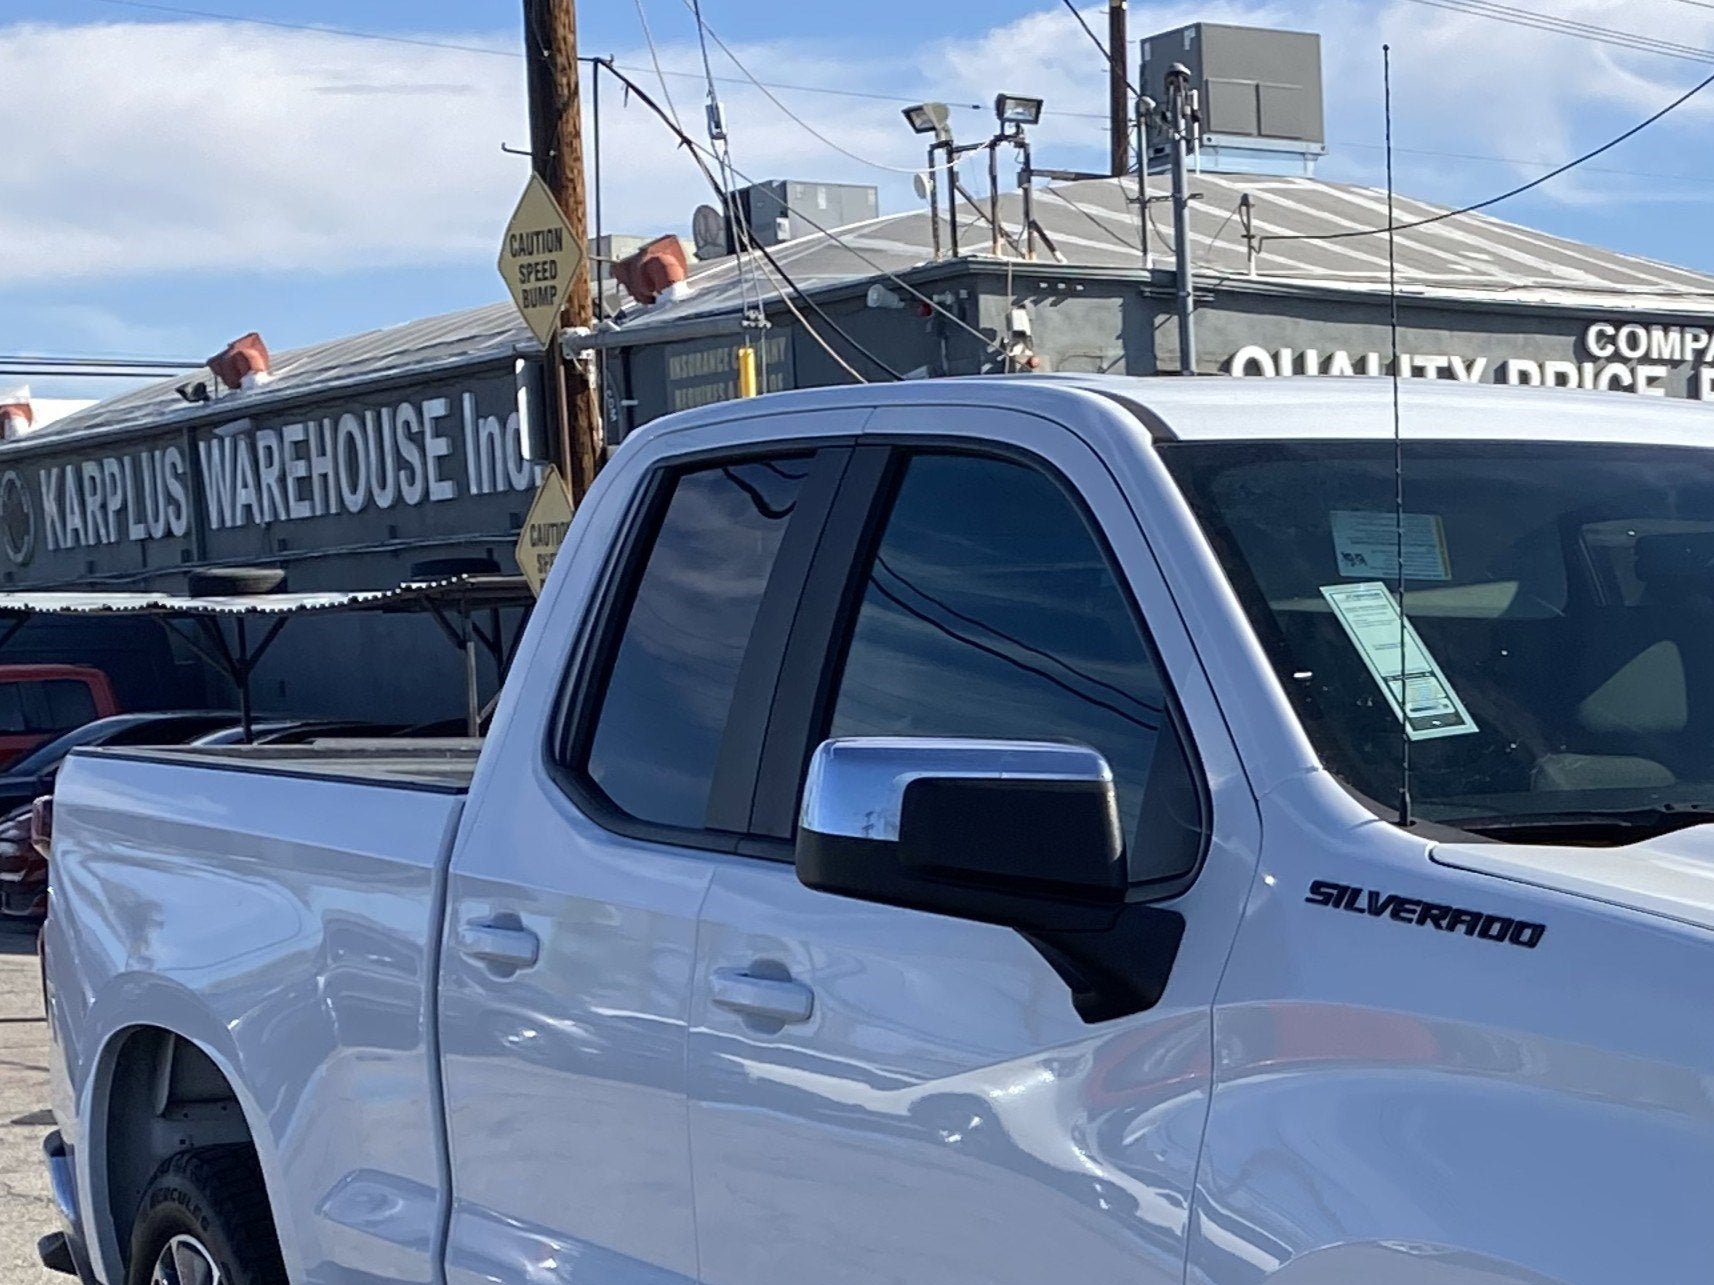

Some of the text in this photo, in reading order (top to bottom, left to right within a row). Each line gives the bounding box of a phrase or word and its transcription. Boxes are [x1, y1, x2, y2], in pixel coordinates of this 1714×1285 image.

[509, 227, 563, 258] CAUTION
[518, 259, 558, 285] SPEED
[521, 285, 557, 308] BUMP
[39, 446, 188, 550] KARPLUS
[199, 397, 457, 530] WAREHOUSE
[1304, 880, 1546, 949] SILVERADO
